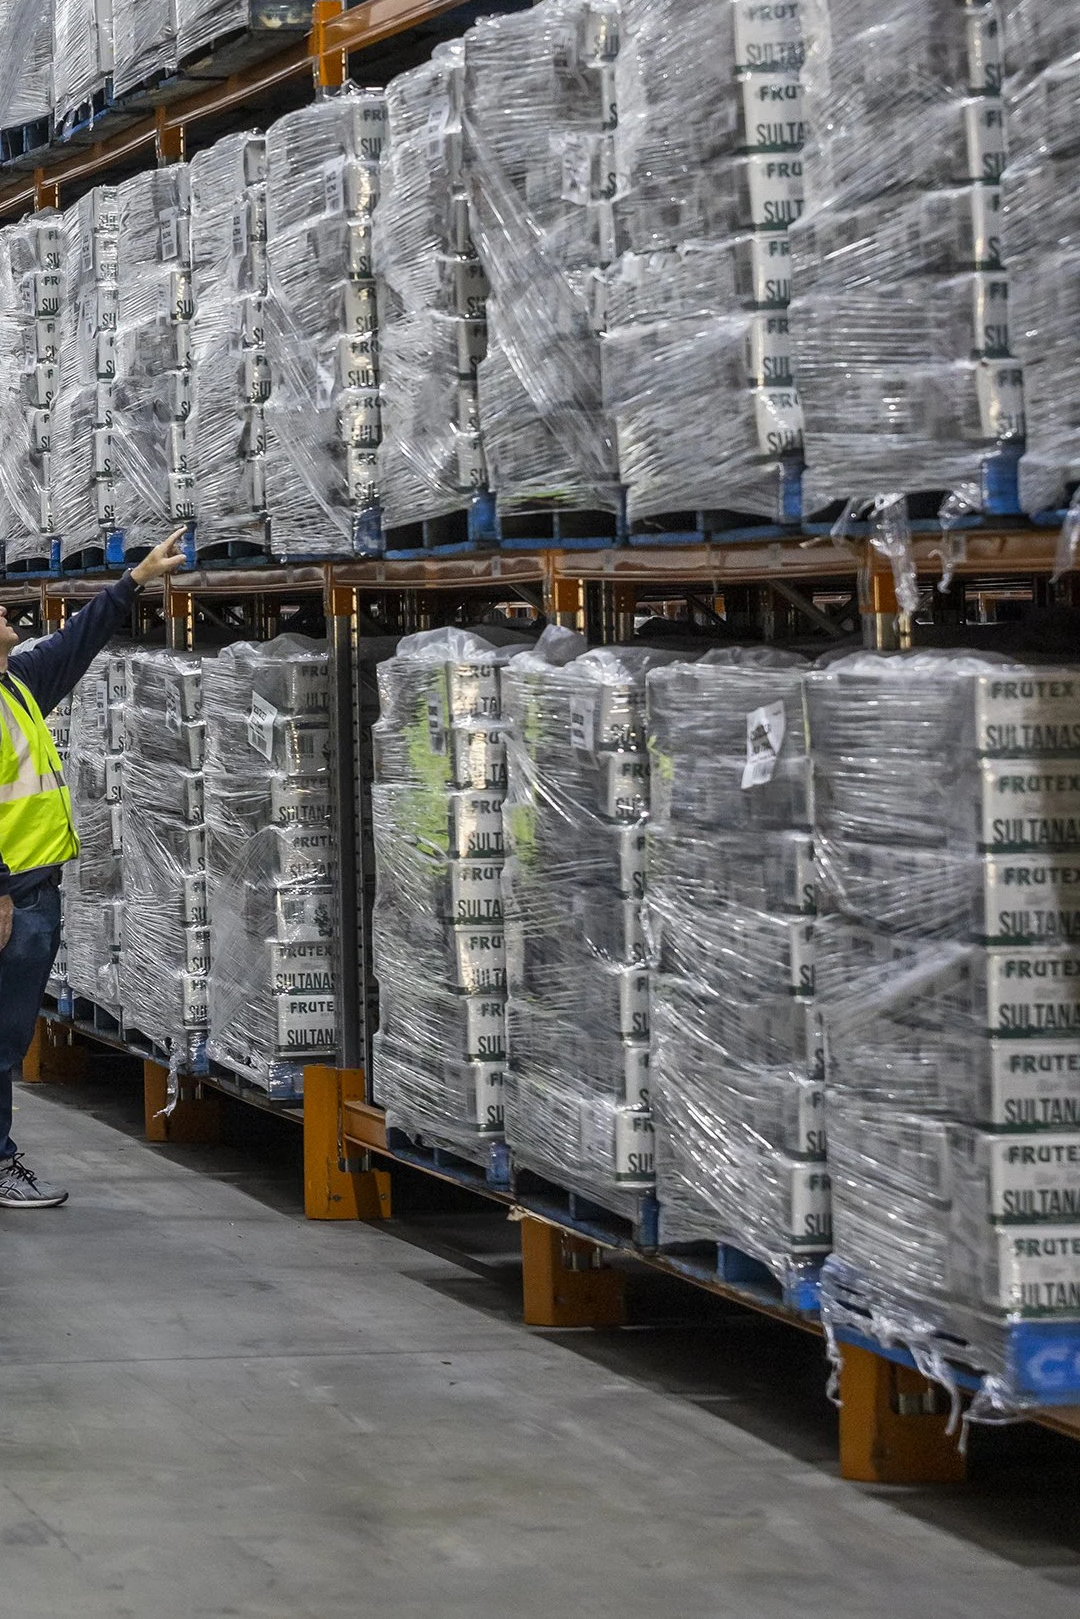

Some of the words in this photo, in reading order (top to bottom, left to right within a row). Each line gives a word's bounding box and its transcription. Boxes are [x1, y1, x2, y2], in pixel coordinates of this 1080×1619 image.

[748, 4, 798, 21] FRUT
[759, 85, 802, 101] FRU
[756, 124, 805, 145] SULTA
[765, 163, 803, 179] FRU
[764, 201, 805, 224] SULT
[348, 369, 380, 387] SULT
[302, 666, 328, 676] FRU
[991, 681, 1075, 699] FRUTEX
[471, 801, 504, 814] FRU
[992, 818, 1080, 843] SULTANA
[469, 832, 504, 851] SULT
[461, 867, 504, 881] FRUT
[458, 899, 504, 918] SULTA
[999, 911, 1080, 934] SULTANA
[470, 936, 504, 950] FRU
[290, 1001, 334, 1013] FRUTE
[999, 1003, 1080, 1028] SULTANA
[287, 1029, 334, 1045] SULTAN
[1009, 1054, 1080, 1073] FRUTE
[1004, 1098, 1080, 1122] SULTAN
[1008, 1145, 1080, 1164] FRUTE
[1003, 1189, 1080, 1213] SULTAN
[1014, 1238, 1080, 1256] FRUTE
